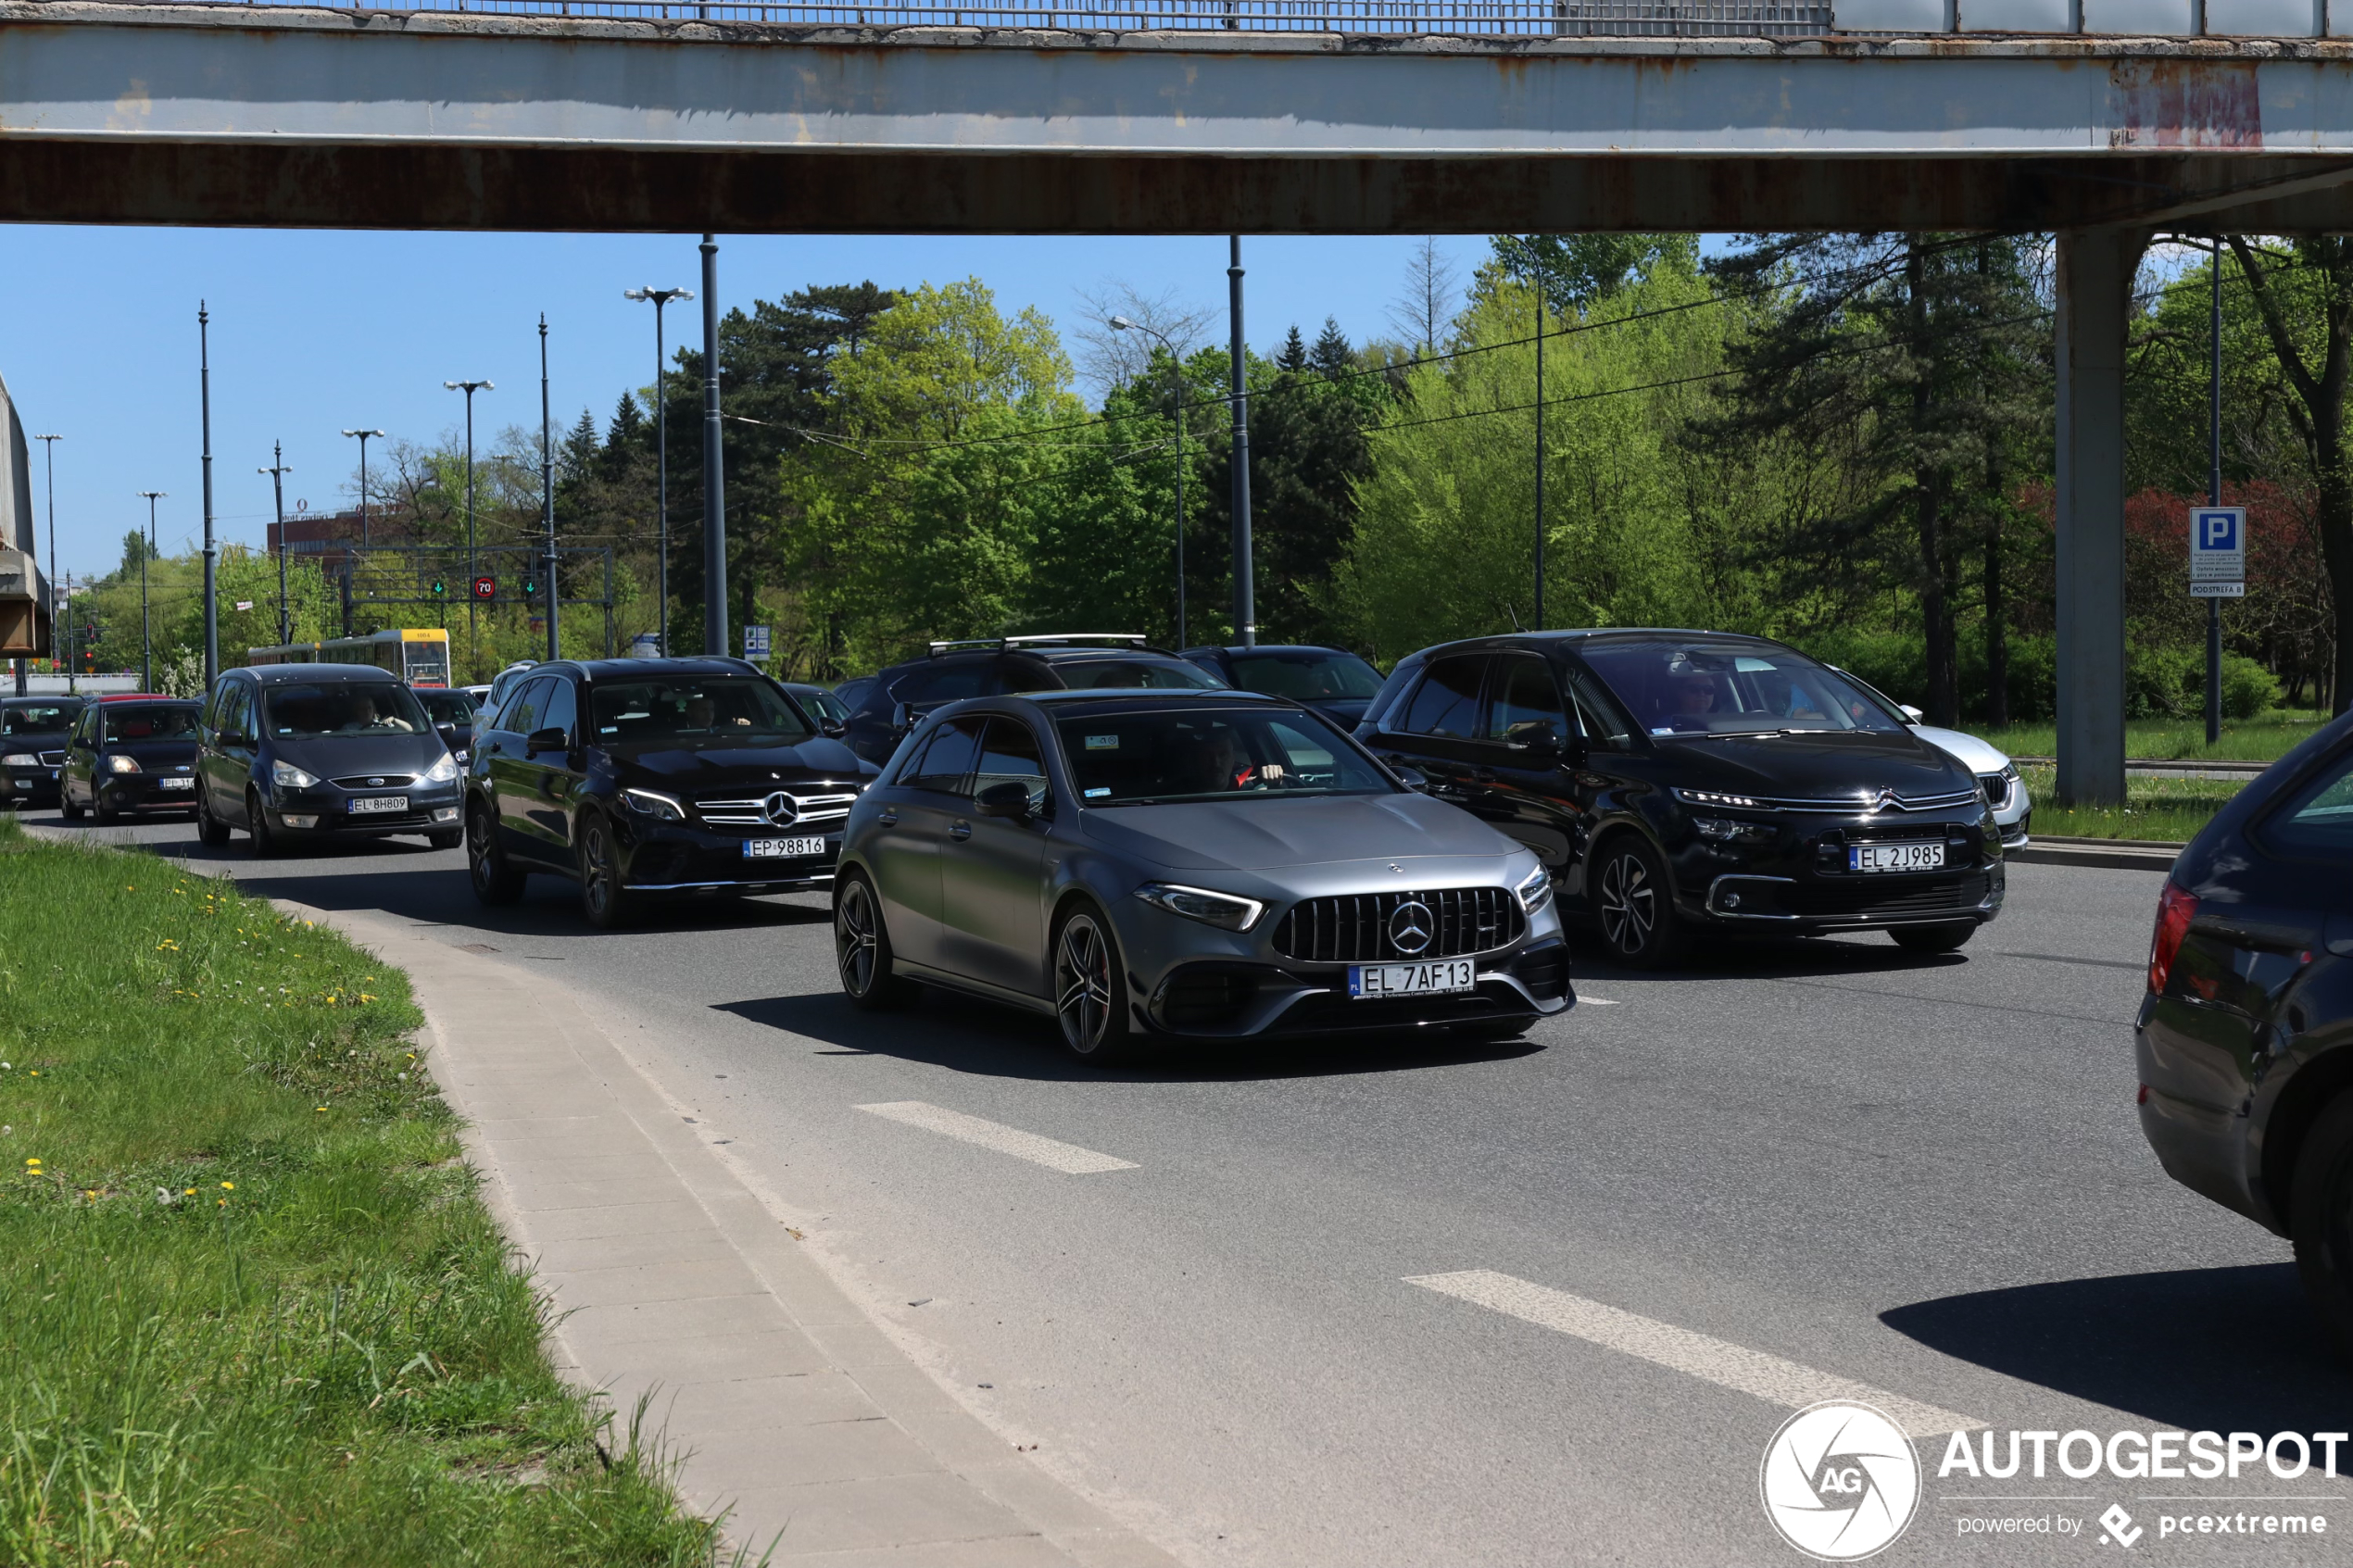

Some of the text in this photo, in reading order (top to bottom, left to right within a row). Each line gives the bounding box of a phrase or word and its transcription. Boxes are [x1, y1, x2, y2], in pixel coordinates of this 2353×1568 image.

[2208, 517, 2229, 546] P
[479, 583, 491, 593] 70
[355, 800, 370, 810] EL
[373, 798, 406, 809] 8H809
[752, 840, 772, 856] EP
[777, 838, 822, 855] 98816
[1861, 848, 1883, 869] EL
[1891, 845, 1942, 867] 2J985
[1365, 967, 1394, 992] EL
[1403, 961, 1470, 990] 7AF13
